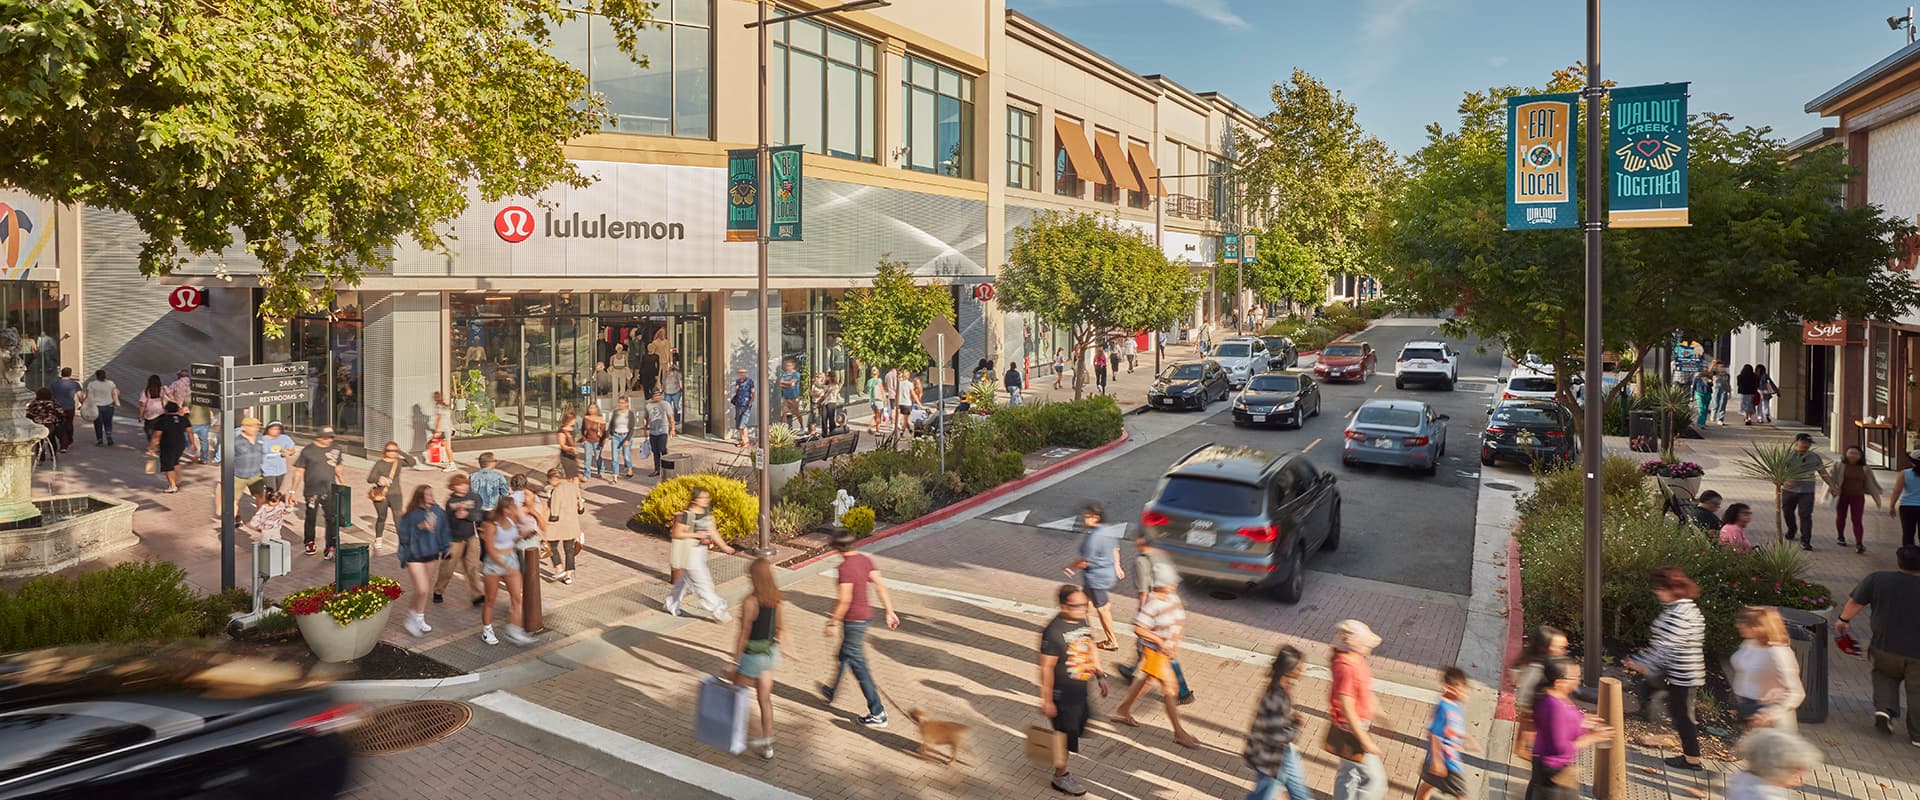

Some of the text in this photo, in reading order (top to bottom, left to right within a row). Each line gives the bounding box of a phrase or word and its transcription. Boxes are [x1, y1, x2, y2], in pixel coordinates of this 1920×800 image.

[1618, 99, 1680, 129] WALNUT
[1529, 108, 1556, 139] EAT
[1627, 123, 1669, 135] CREEK
[782, 156, 792, 176] BE
[1520, 171, 1563, 196] LOCAL
[1616, 170, 1681, 197] TOGETHER
[1526, 207, 1557, 222] WALNUT
[545, 211, 685, 241] lululemon
[631, 304, 650, 312] 1210
[1808, 324, 1843, 337] Saje
[272, 365, 297, 374] MACY'S
[279, 379, 297, 387] ZARA
[259, 394, 297, 403] RESTROOMS
